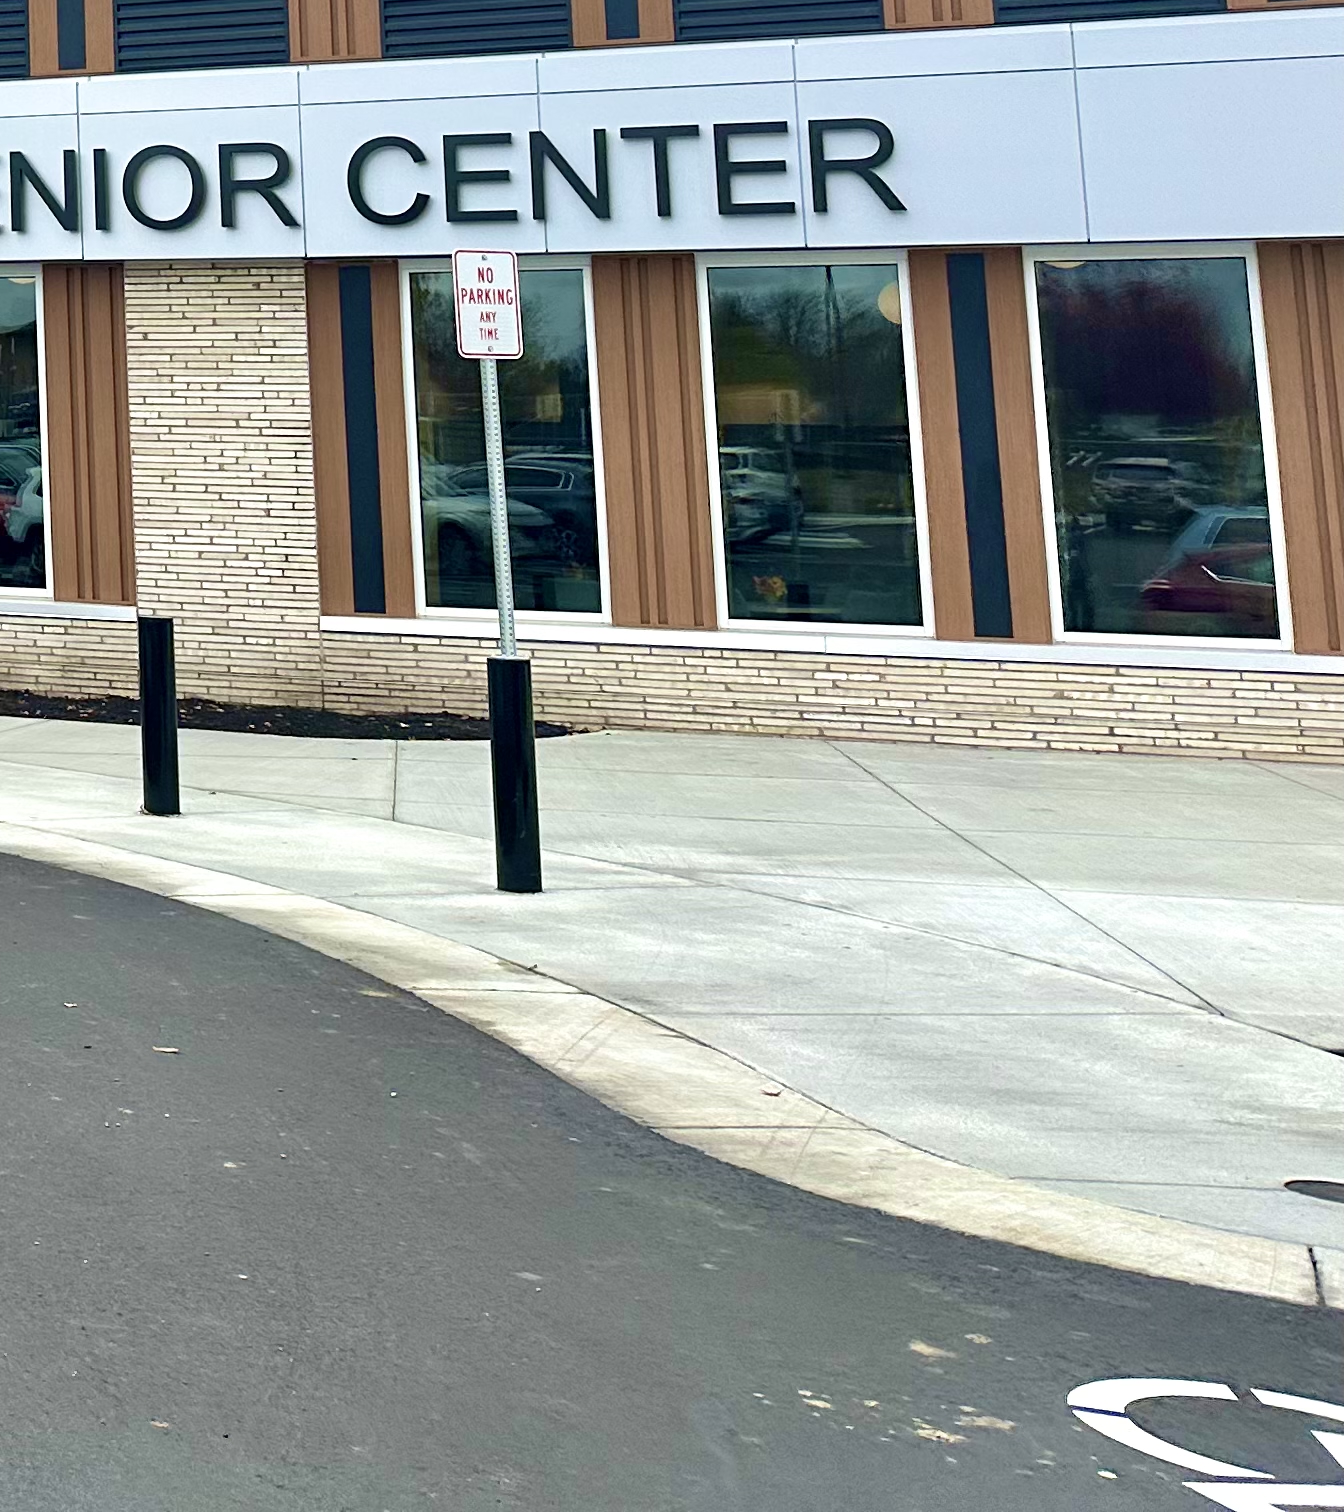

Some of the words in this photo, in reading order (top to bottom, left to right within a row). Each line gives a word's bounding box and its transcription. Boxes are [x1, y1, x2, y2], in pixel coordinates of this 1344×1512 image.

[346, 118, 908, 225] CENTER
[477, 267, 494, 283] NO
[461, 288, 514, 305] PARKING
[479, 311, 496, 323] ANY
[479, 328, 499, 340] TIME
